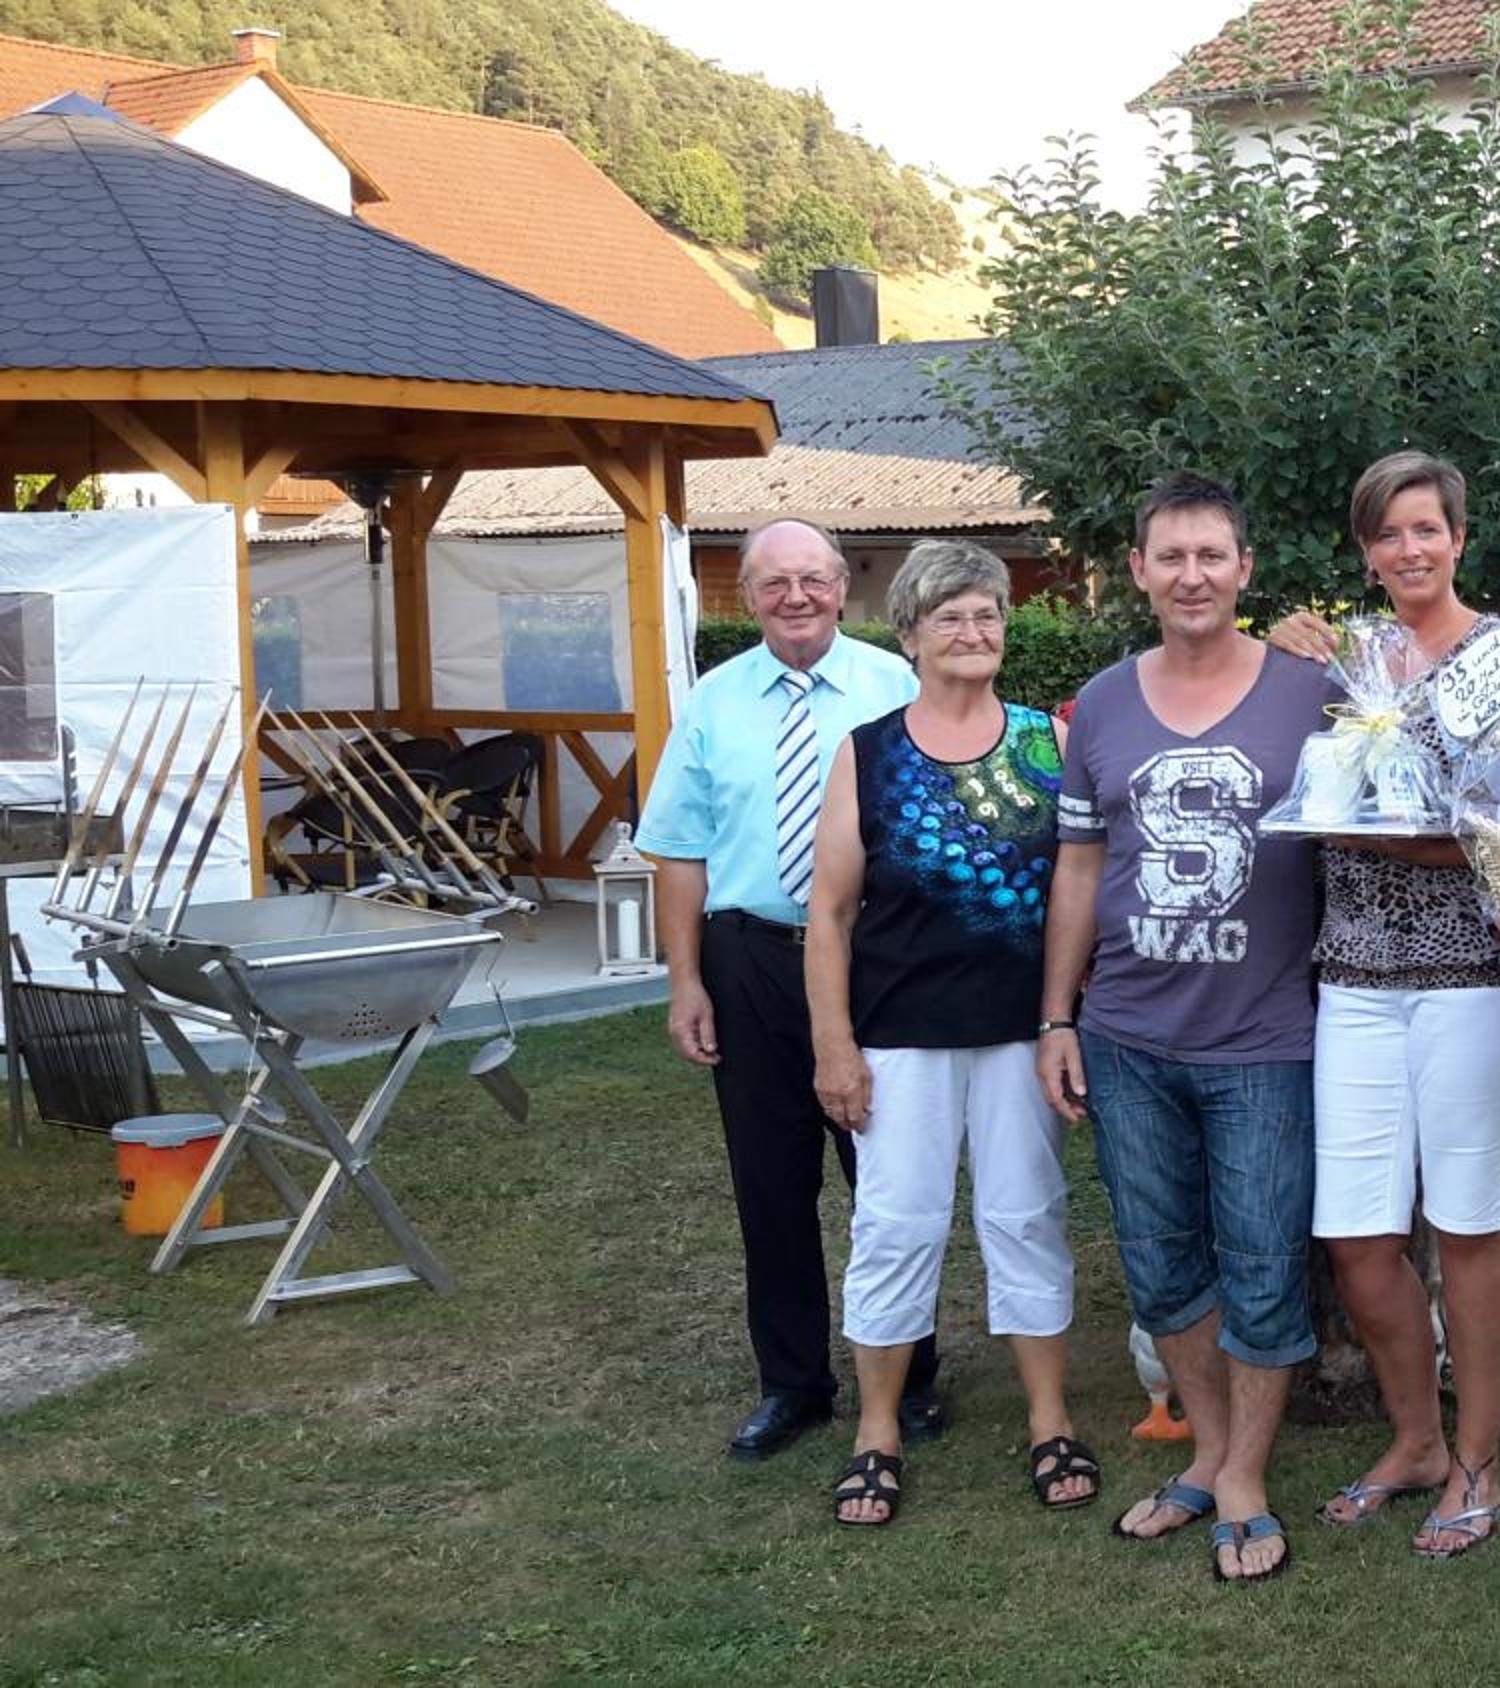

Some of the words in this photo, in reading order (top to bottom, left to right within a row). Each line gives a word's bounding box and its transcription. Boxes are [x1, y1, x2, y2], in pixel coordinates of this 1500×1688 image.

[1442, 660, 1468, 693] 35
[1455, 679, 1475, 702] 20
[1128, 745, 1264, 918] S
